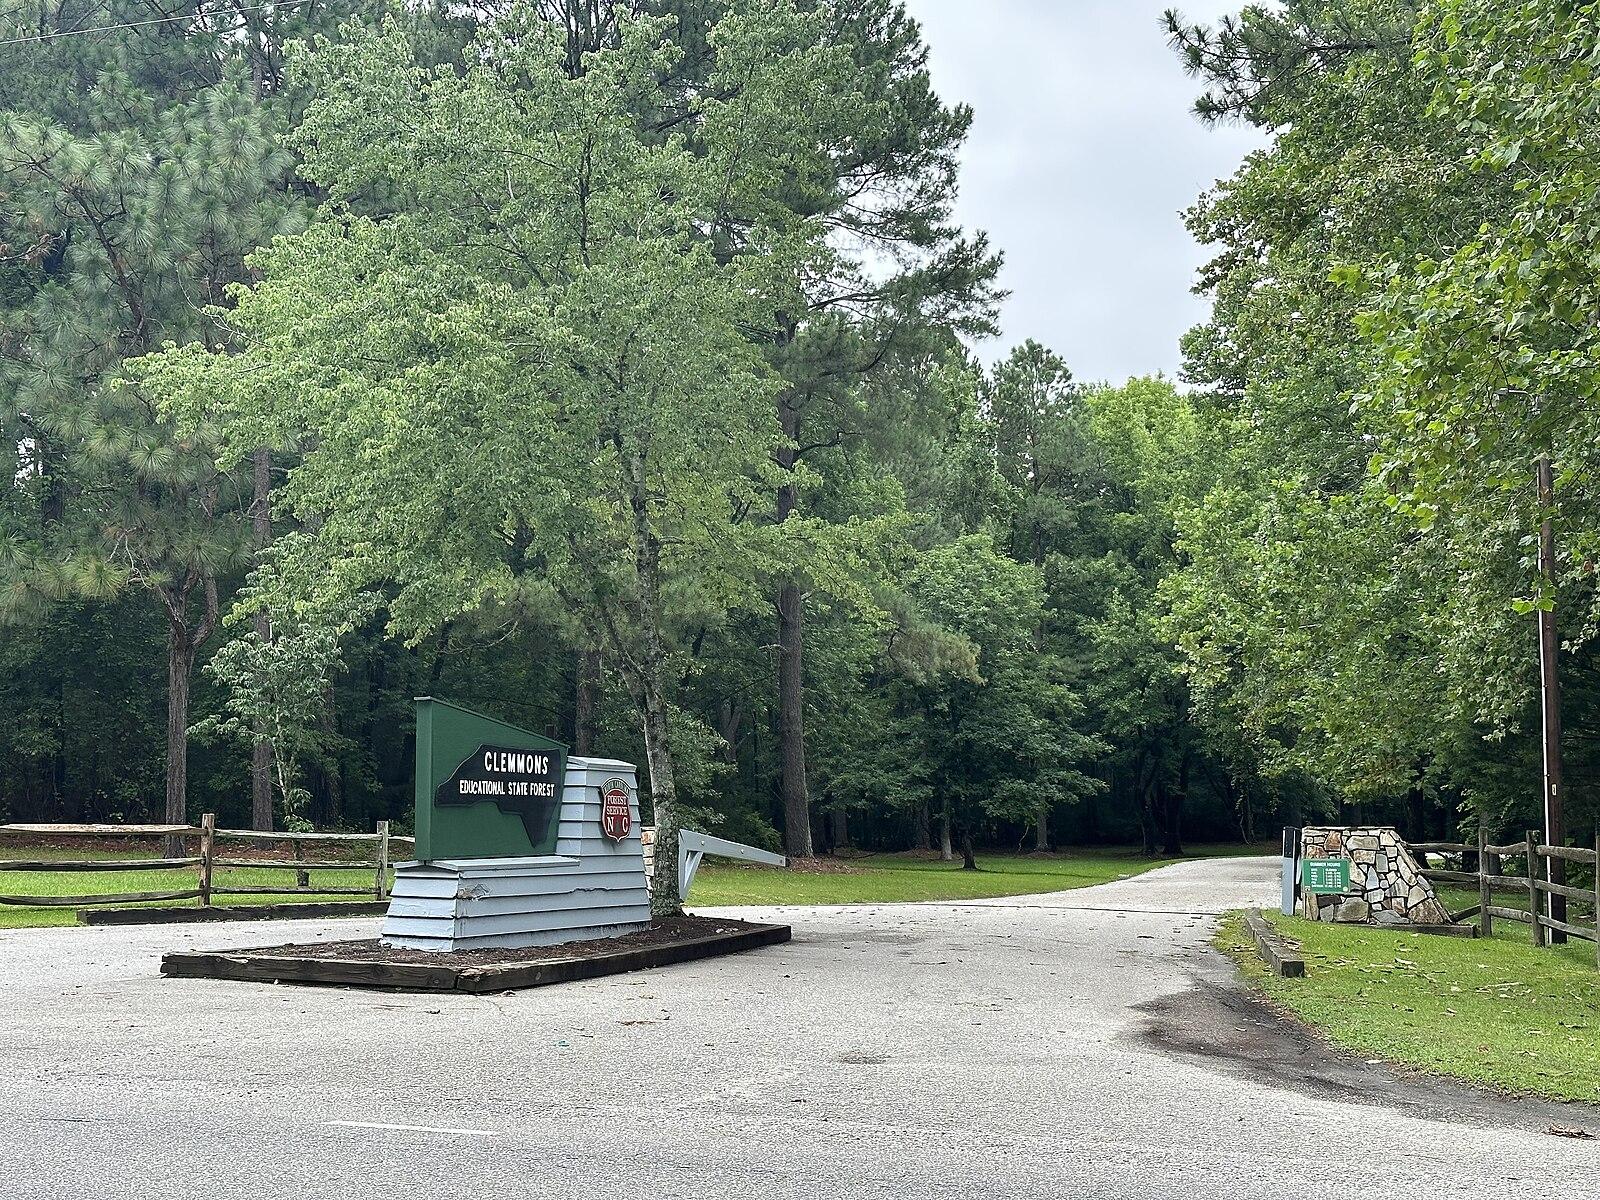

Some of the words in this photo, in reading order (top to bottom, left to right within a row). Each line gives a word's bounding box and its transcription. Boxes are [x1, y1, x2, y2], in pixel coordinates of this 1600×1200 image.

[484, 751, 549, 775] CLEMMONS
[459, 780, 506, 795] EDUCATIONAL
[508, 782, 528, 796] STATE
[529, 782, 555, 797] FOREST
[606, 795, 628, 805] FOREST
[606, 805, 628, 816] SERVICE
